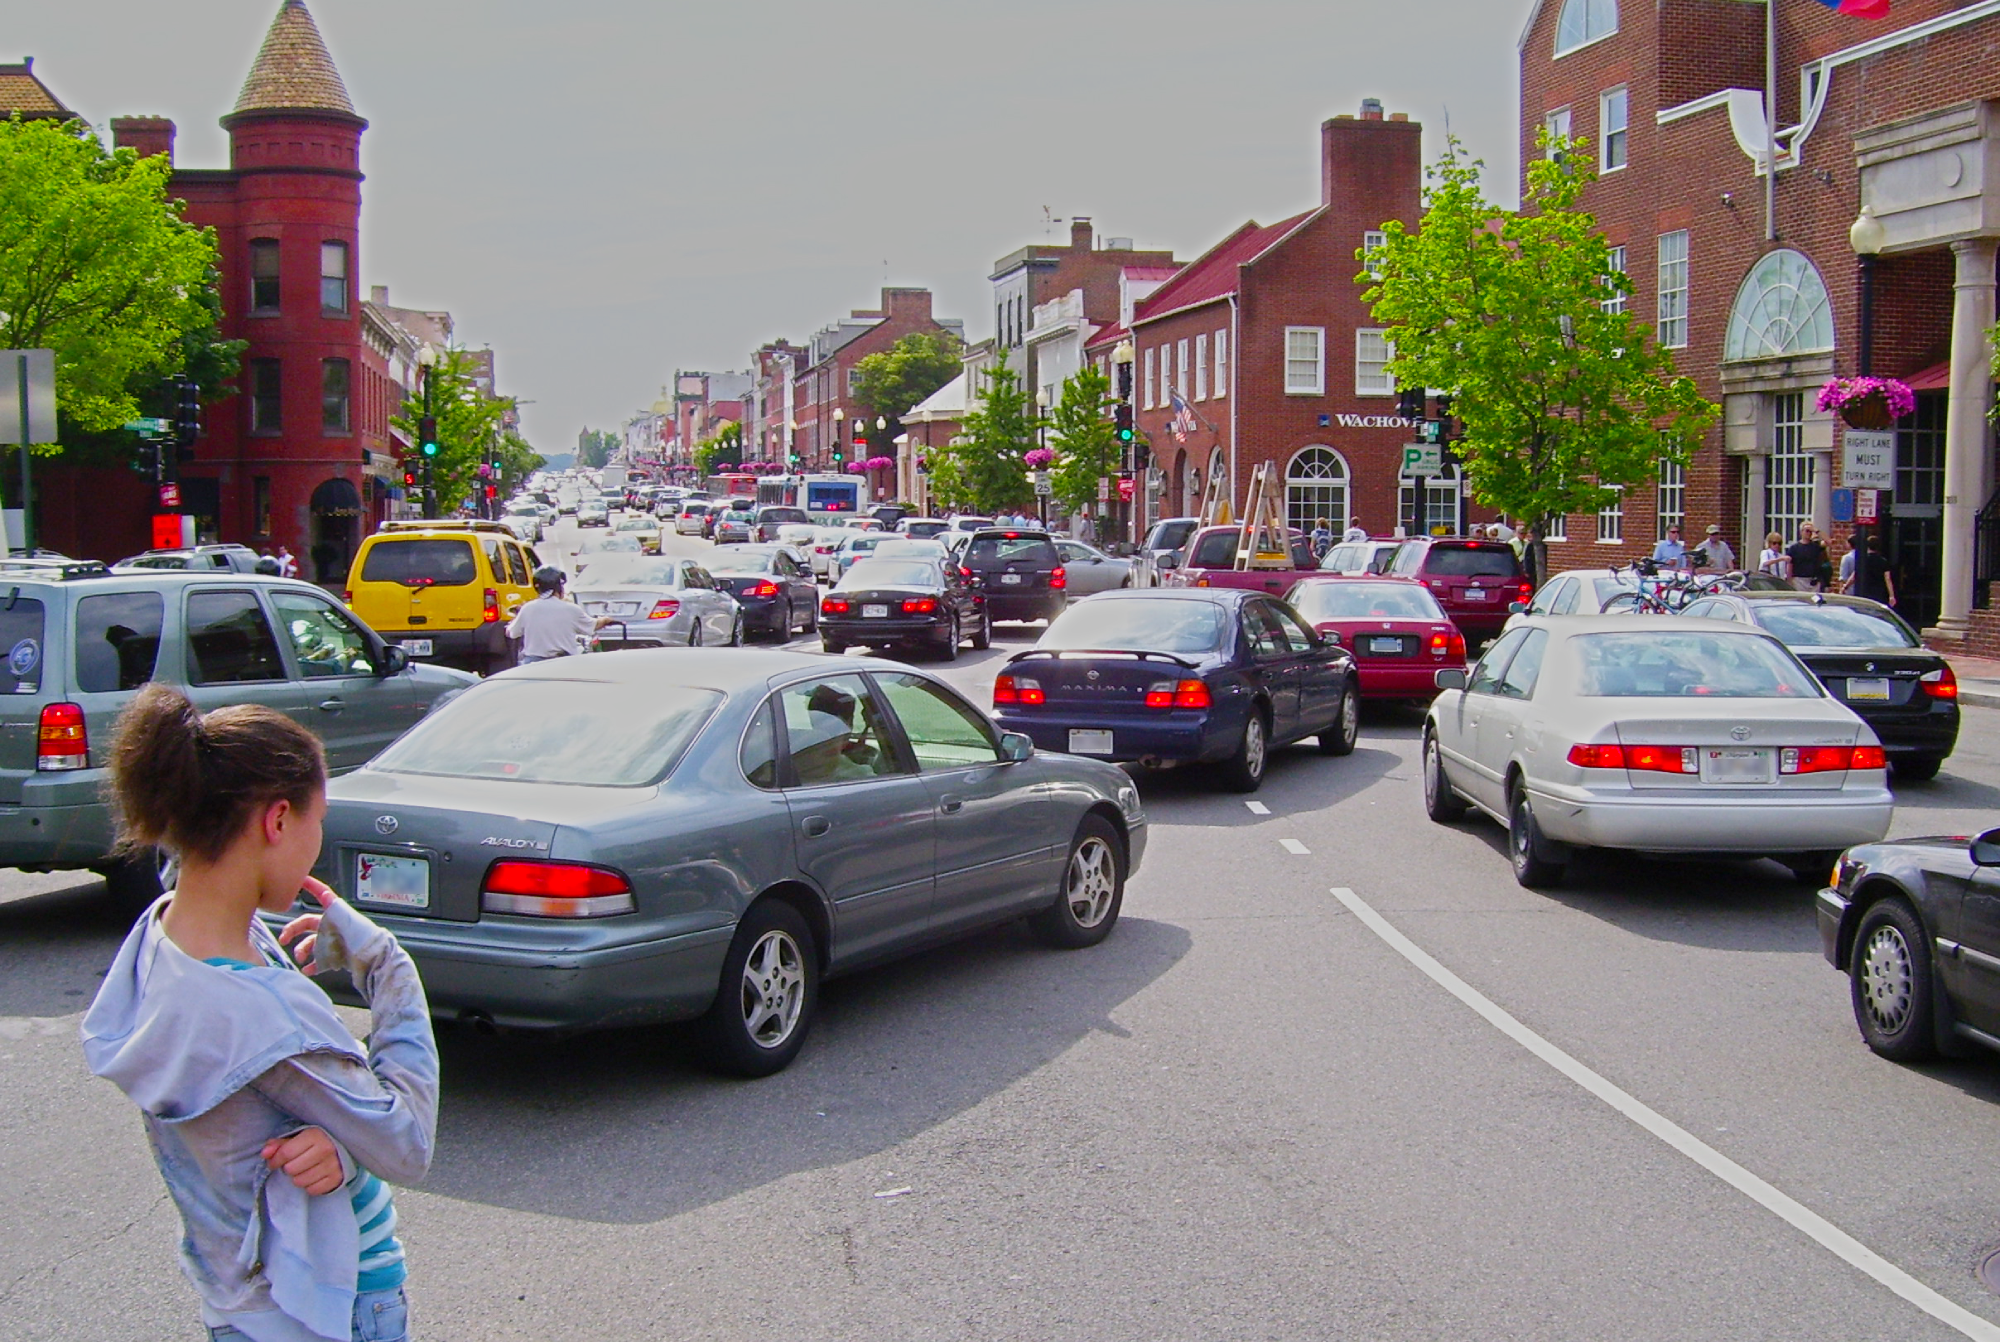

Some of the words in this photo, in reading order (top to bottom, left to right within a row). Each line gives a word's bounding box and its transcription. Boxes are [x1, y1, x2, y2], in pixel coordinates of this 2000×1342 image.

[1846, 438, 1869, 448] RIGHT
[1872, 439, 1891, 449] LANE
[1405, 449, 1422, 470] P
[1856, 454, 1881, 466] MUST
[1845, 471, 1865, 480] TURN
[1869, 472, 1890, 481] RIGHT
[1037, 484, 1051, 493] 25
[1061, 684, 1127, 692] MAXIMA
